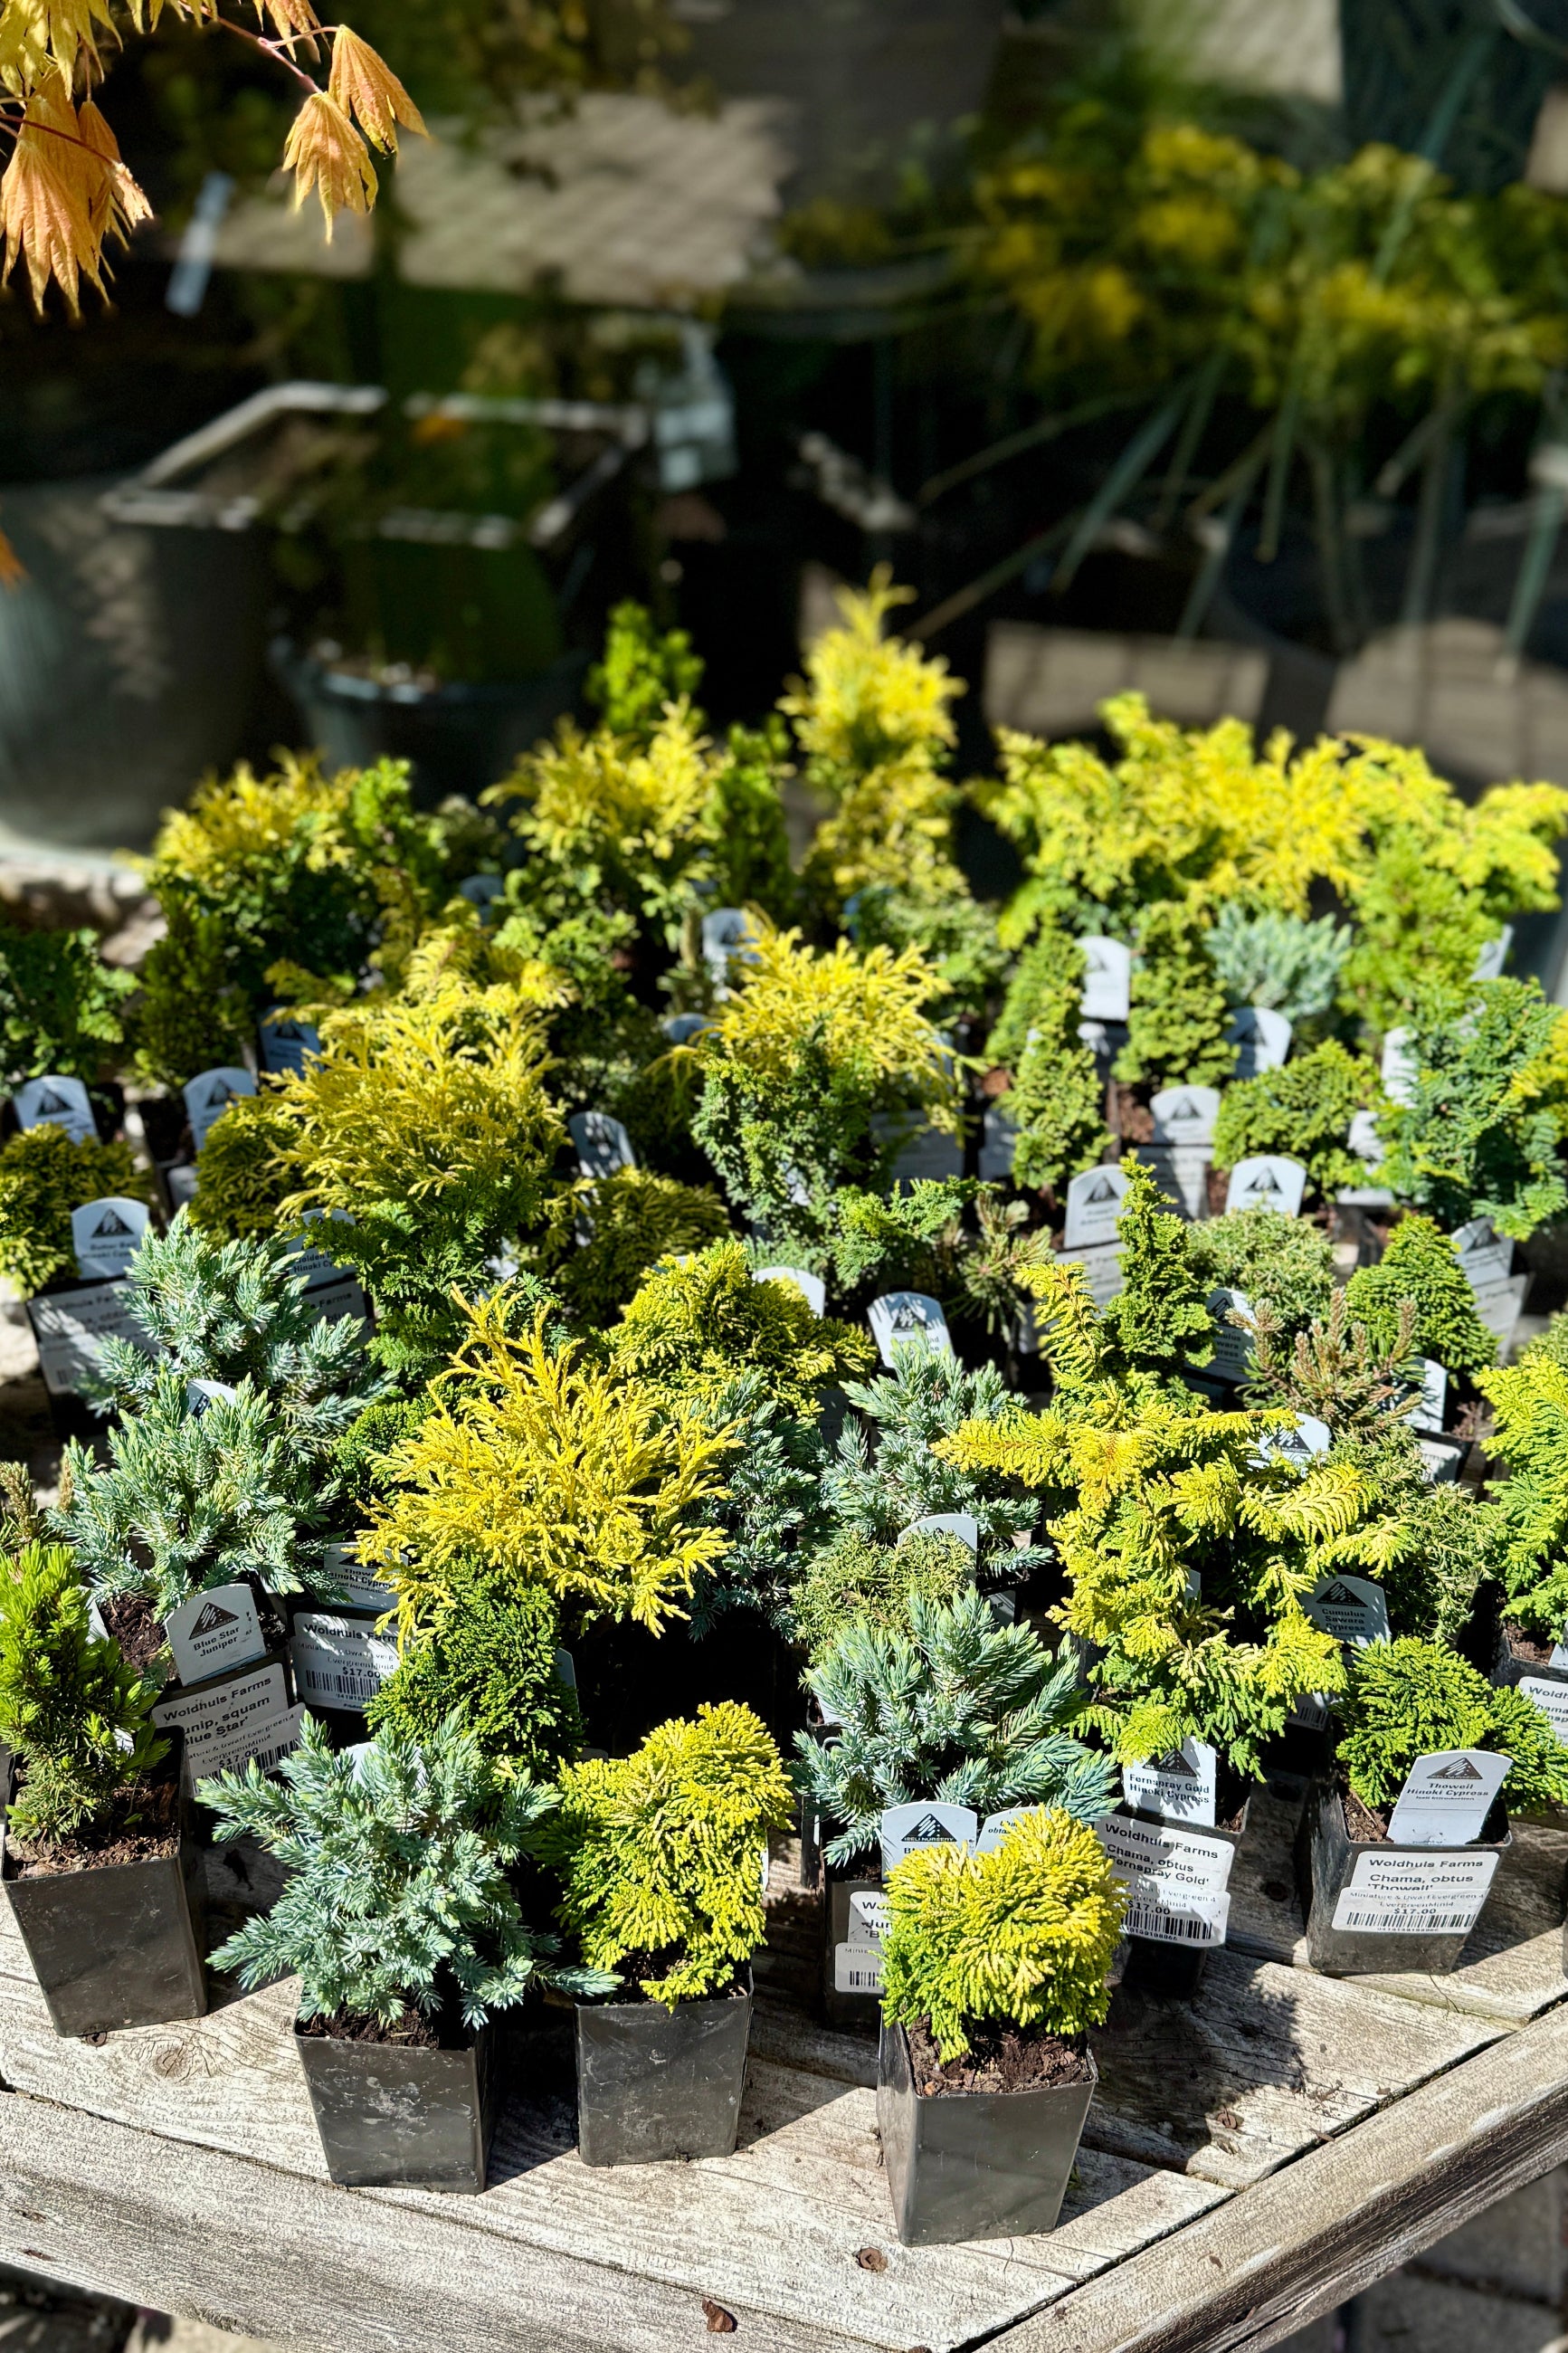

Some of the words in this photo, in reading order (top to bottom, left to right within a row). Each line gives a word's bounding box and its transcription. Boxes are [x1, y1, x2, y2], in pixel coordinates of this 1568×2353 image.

[1322, 1608, 1365, 1617] Cumulus
[1325, 1615, 1365, 1624] Sawara
[194, 1637, 217, 1652] Blue
[219, 1626, 240, 1640] Star
[367, 1631, 398, 1643] Farm
[200, 1636, 238, 1657] Juniper
[342, 1666, 381, 1679] $17.00
[231, 1676, 272, 1699] Farms
[1529, 1686, 1568, 1700] Woldh
[185, 1718, 219, 1735] unip,
[222, 1696, 271, 1722] squam
[218, 1747, 260, 1768] $17.00
[1129, 1773, 1182, 1791] Fernspray
[1184, 1783, 1210, 1795] Gold
[1129, 1783, 1164, 1796] Hinoki
[1167, 1789, 1210, 1804] Cypress
[1107, 1843, 1154, 1865] Chama,
[1157, 1858, 1194, 1873] obtus
[1174, 1843, 1219, 1859] Farms
[1439, 1860, 1484, 1868] Farms
[1175, 1872, 1209, 1886] Gold'
[1369, 1873, 1426, 1883] Chama,
[1430, 1874, 1474, 1882] obtus
[1127, 1900, 1171, 1915] $17.00
